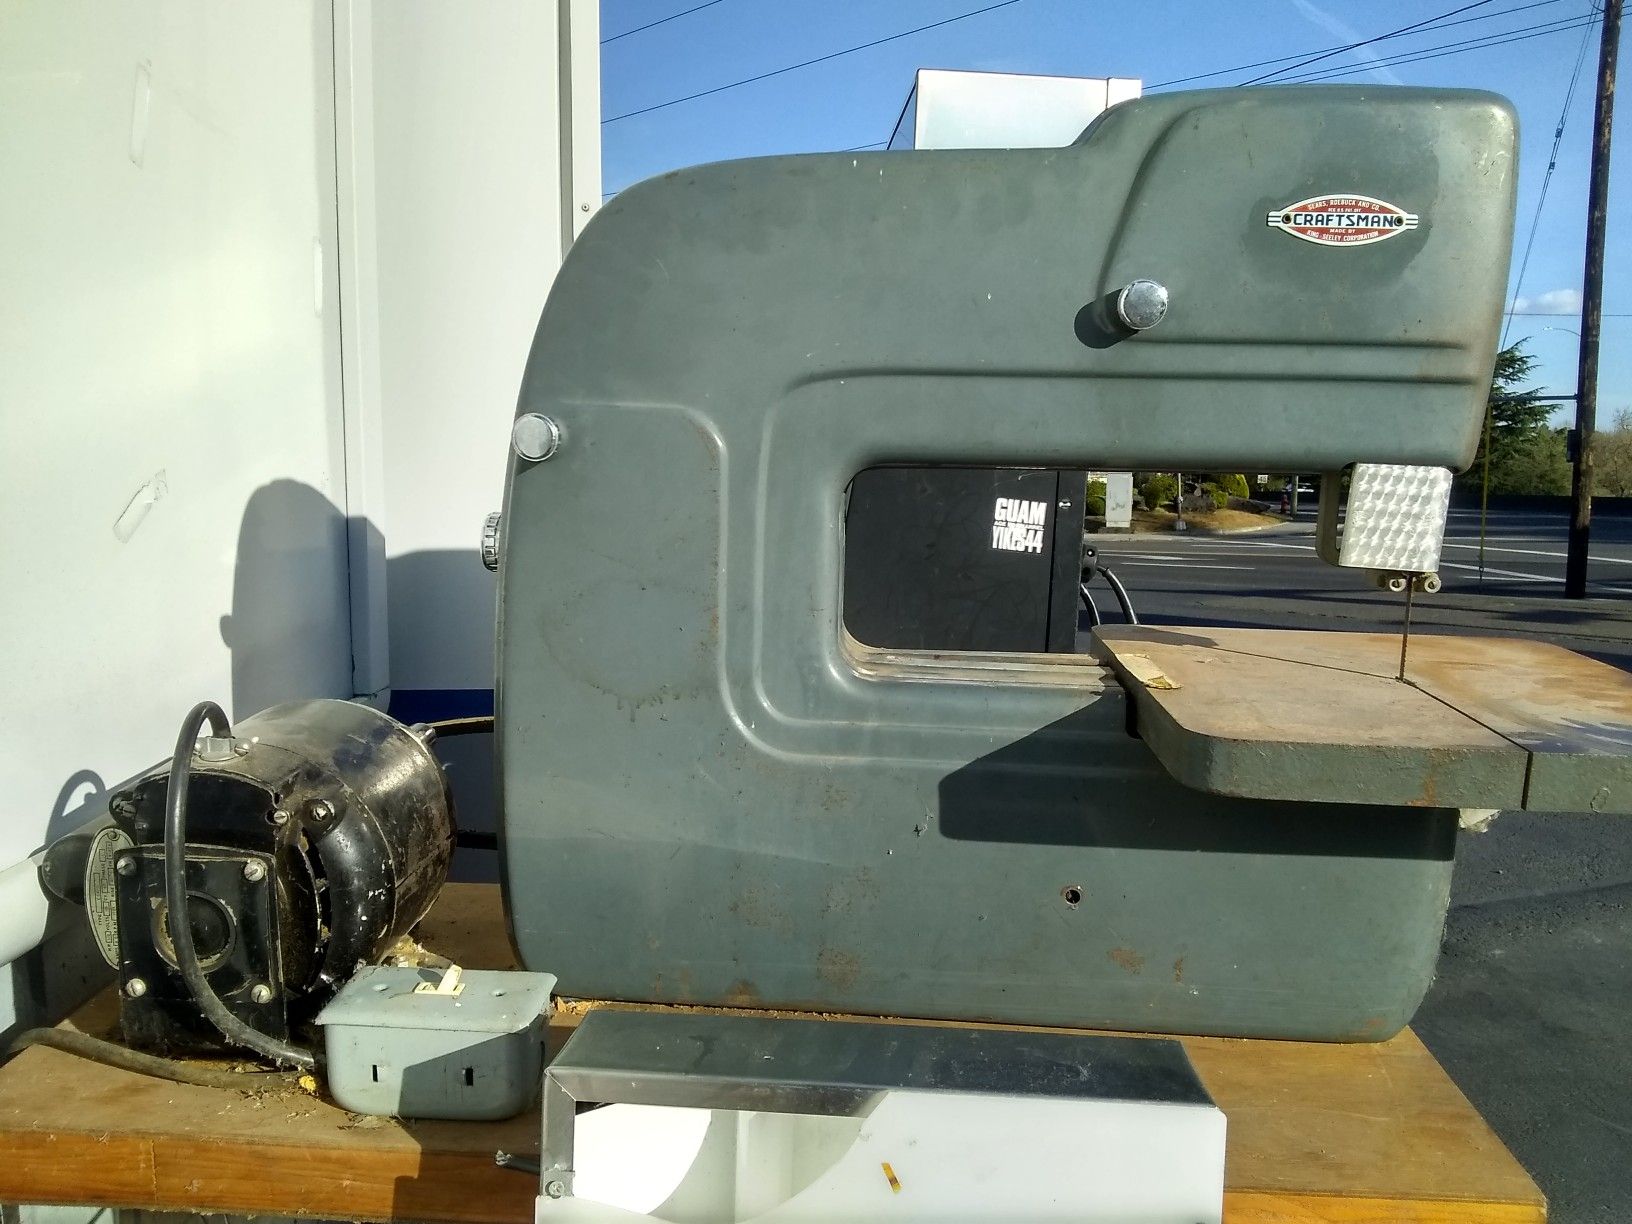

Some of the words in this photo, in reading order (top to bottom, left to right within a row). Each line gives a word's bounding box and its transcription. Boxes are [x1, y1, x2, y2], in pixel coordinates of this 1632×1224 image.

[1357, 200, 1370, 208] AND
[1293, 213, 1394, 227] CRAFTSMAN
[994, 497, 1047, 526] GUAM
